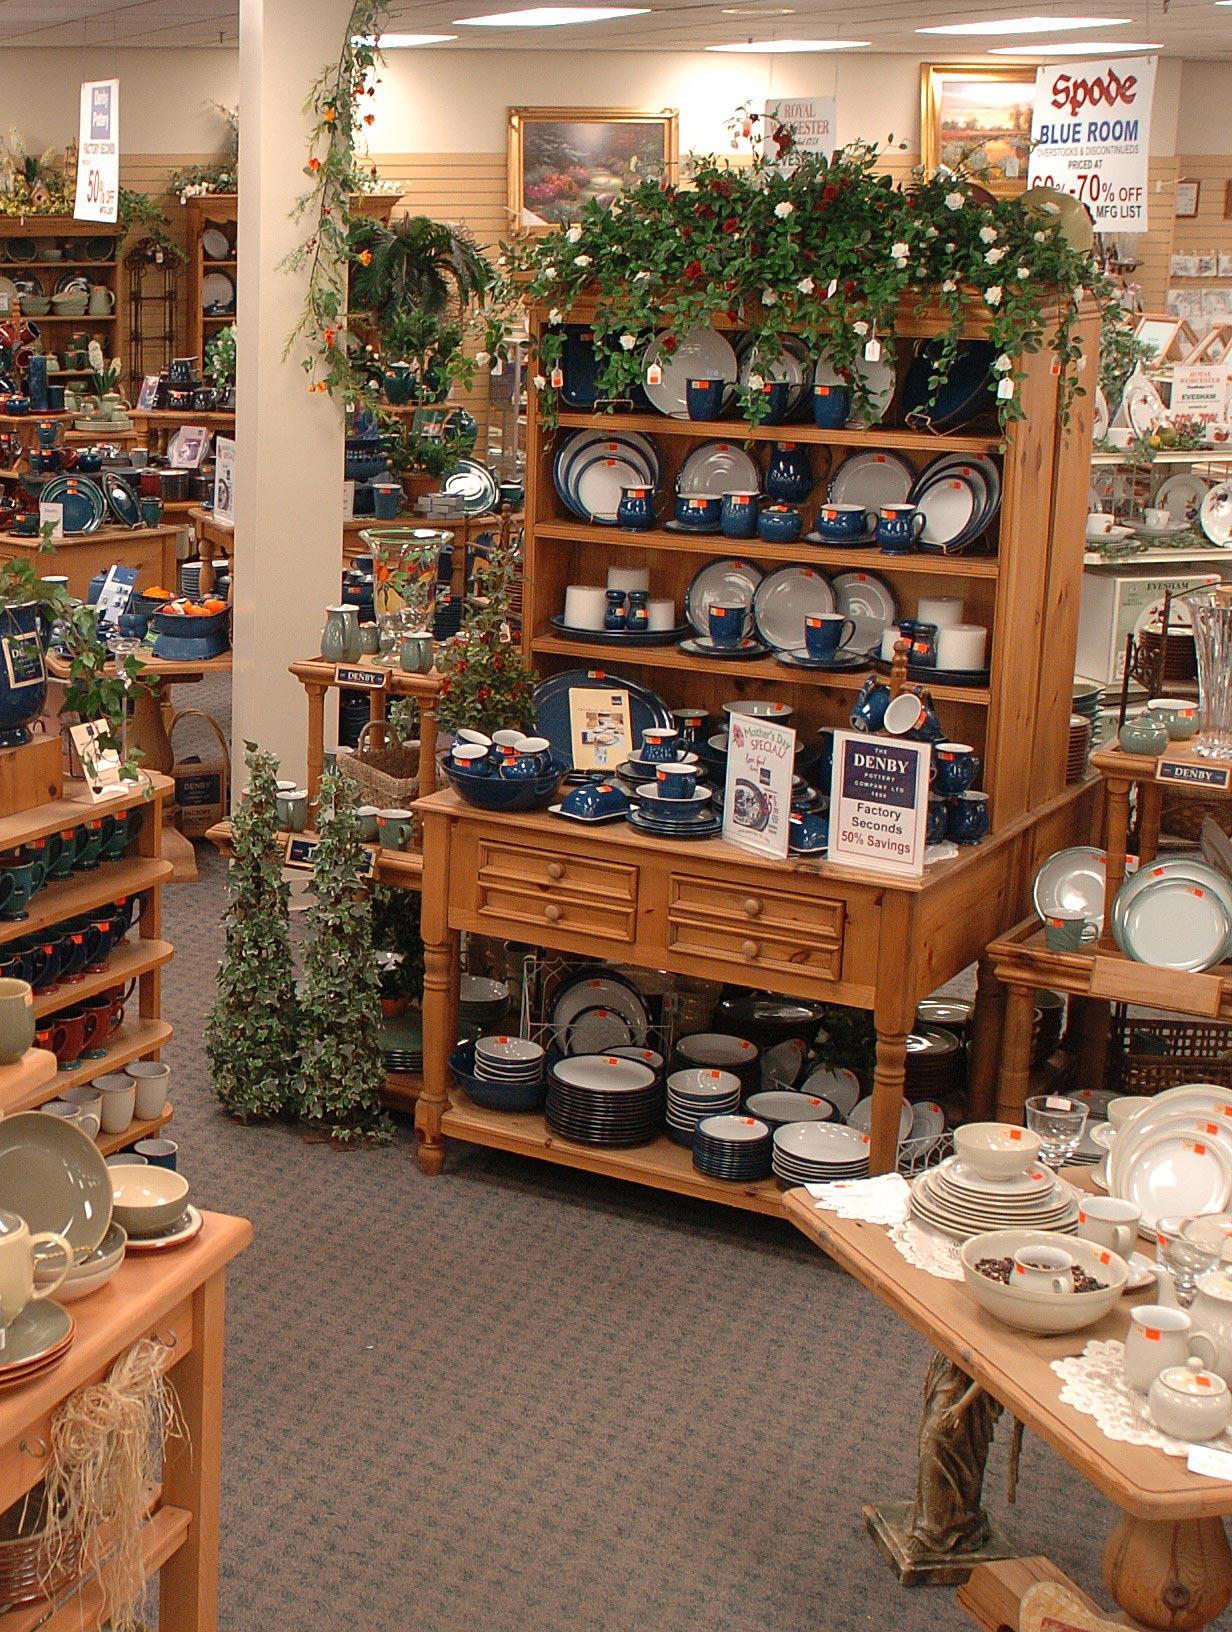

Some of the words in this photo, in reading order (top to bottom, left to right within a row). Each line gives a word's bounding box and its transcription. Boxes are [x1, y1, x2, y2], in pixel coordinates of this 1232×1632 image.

[1051, 68, 1138, 116] Spode
[784, 103, 816, 118] ROYAL
[769, 120, 830, 135] WESTER
[1040, 122, 1082, 144] BLUE
[1087, 120, 1139, 142] ROOM
[1068, 160, 1092, 170] PRICED
[1094, 159, 1103, 169] AT
[1118, 187, 1143, 201] OFF
[1096, 205, 1118, 219] MFG
[1120, 205, 1143, 218] LIST
[1147, 582, 1189, 591] EVESHAM
[348, 671, 375, 682] DENBY
[874, 747, 887, 755] THE
[853, 753, 909, 774] DENBY
[864, 772, 895, 782] POTTERY
[1174, 767, 1213, 781] DENBY
[854, 780, 887, 790] COMPANY
[857, 802, 901, 821] Factory
[851, 816, 903, 835] Seconds
[841, 830, 864, 846] 50%
[867, 835, 911, 855] Savings
